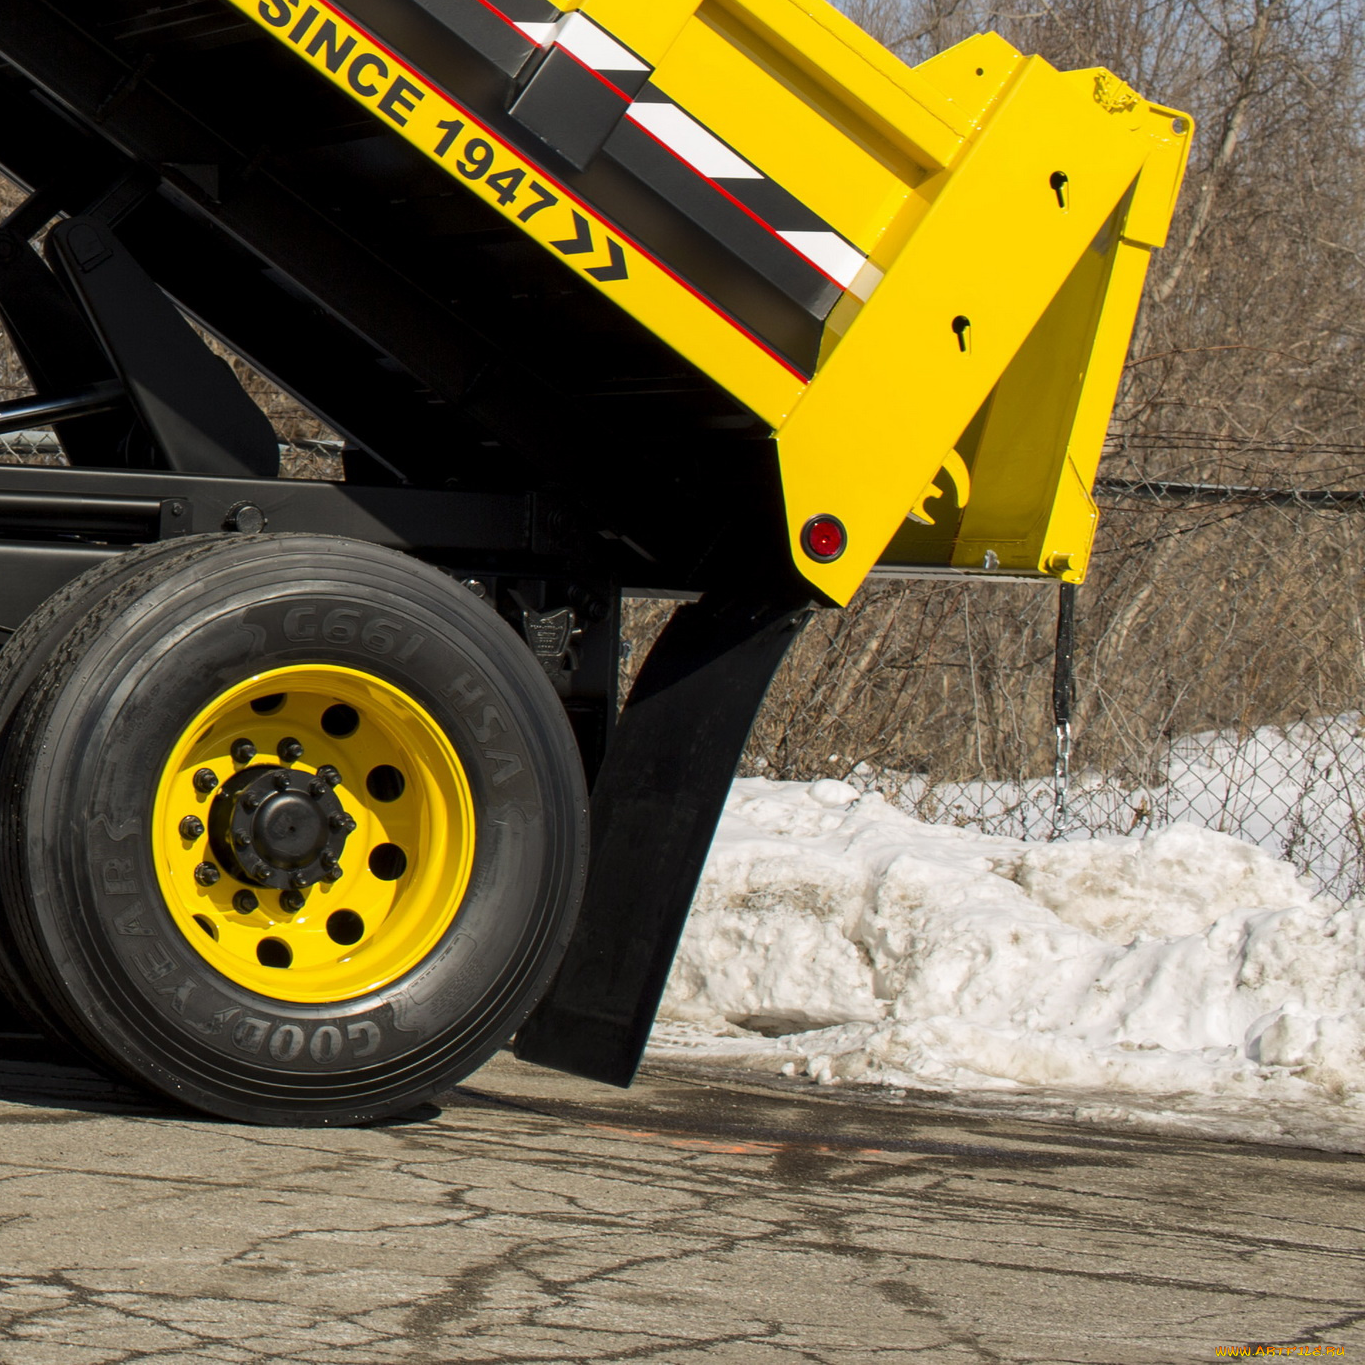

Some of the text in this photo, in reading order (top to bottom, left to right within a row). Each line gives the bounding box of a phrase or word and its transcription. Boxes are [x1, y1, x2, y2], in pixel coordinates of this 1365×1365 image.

[434, 118, 560, 225] 1947
[282, 604, 526, 785] G661 HSA
